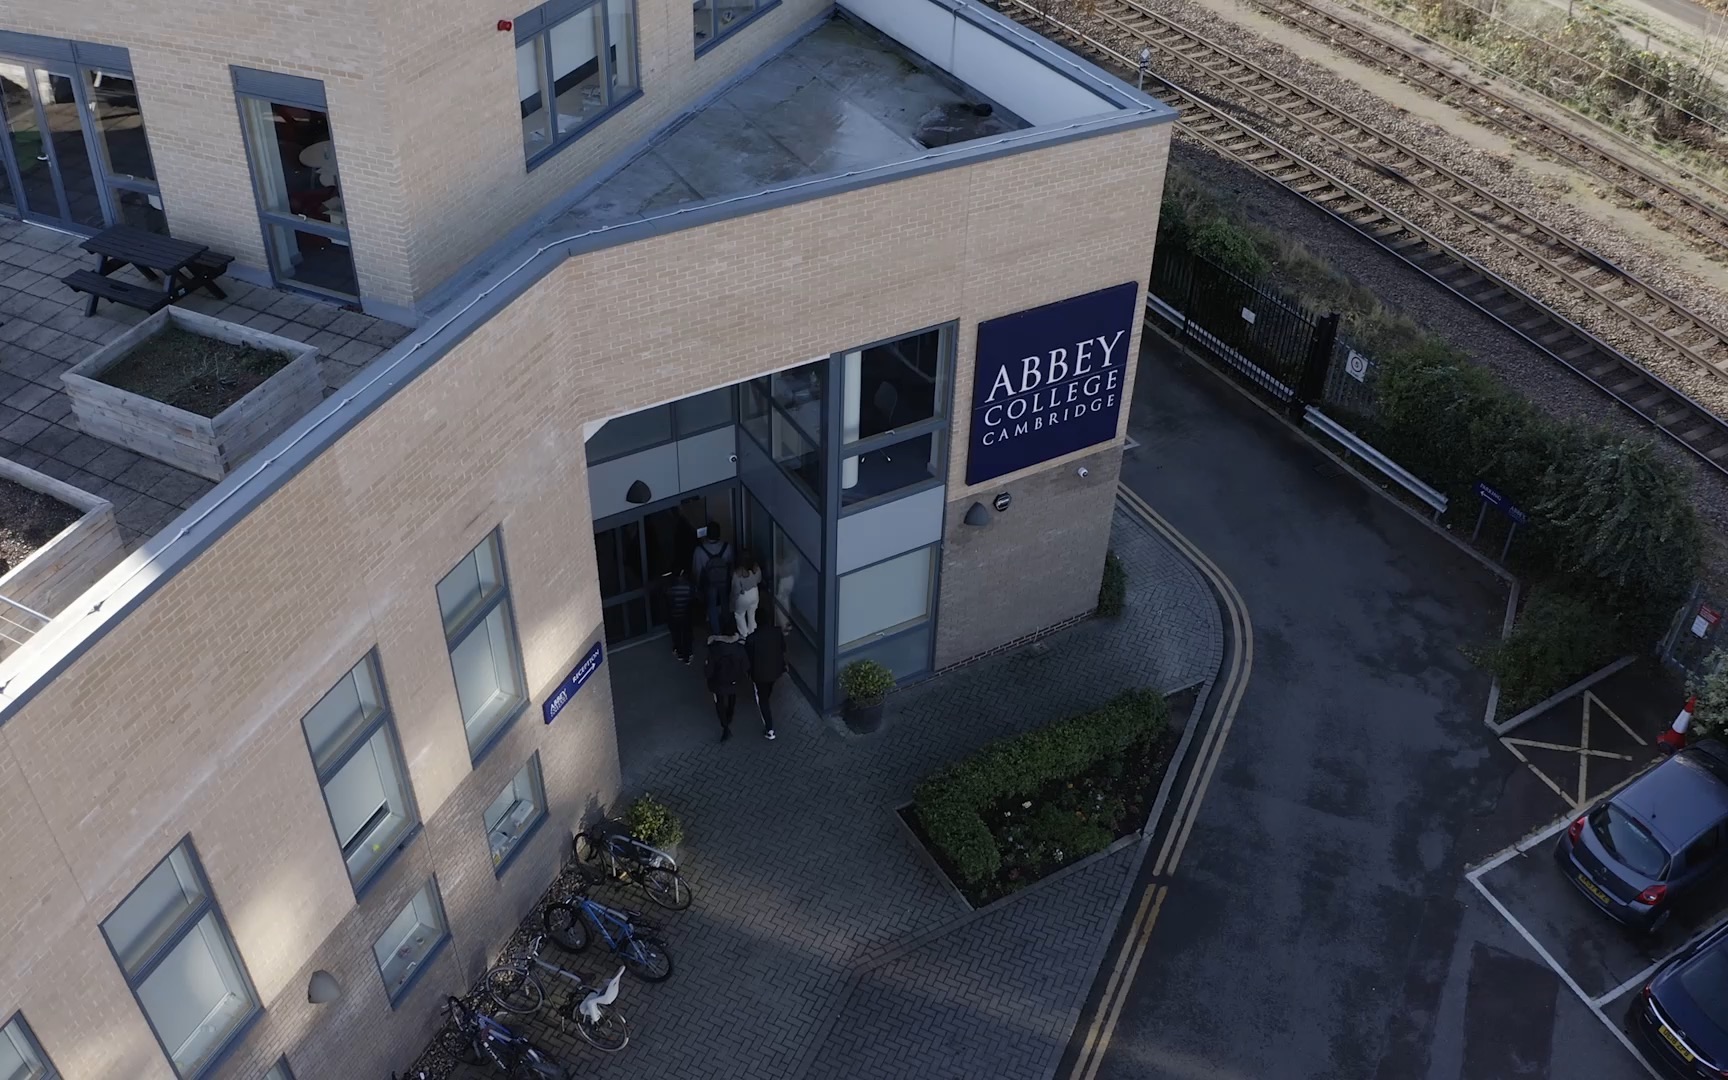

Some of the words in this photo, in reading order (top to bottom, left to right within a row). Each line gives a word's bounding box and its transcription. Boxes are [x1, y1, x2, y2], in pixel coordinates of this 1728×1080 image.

[984, 330, 1125, 403] ABBEY
[982, 394, 1115, 446] CAMBRIDGE
[984, 370, 1118, 426] COLLEGE
[1480, 483, 1501, 501] PARKING
[572, 648, 600, 683] RECEPTION
